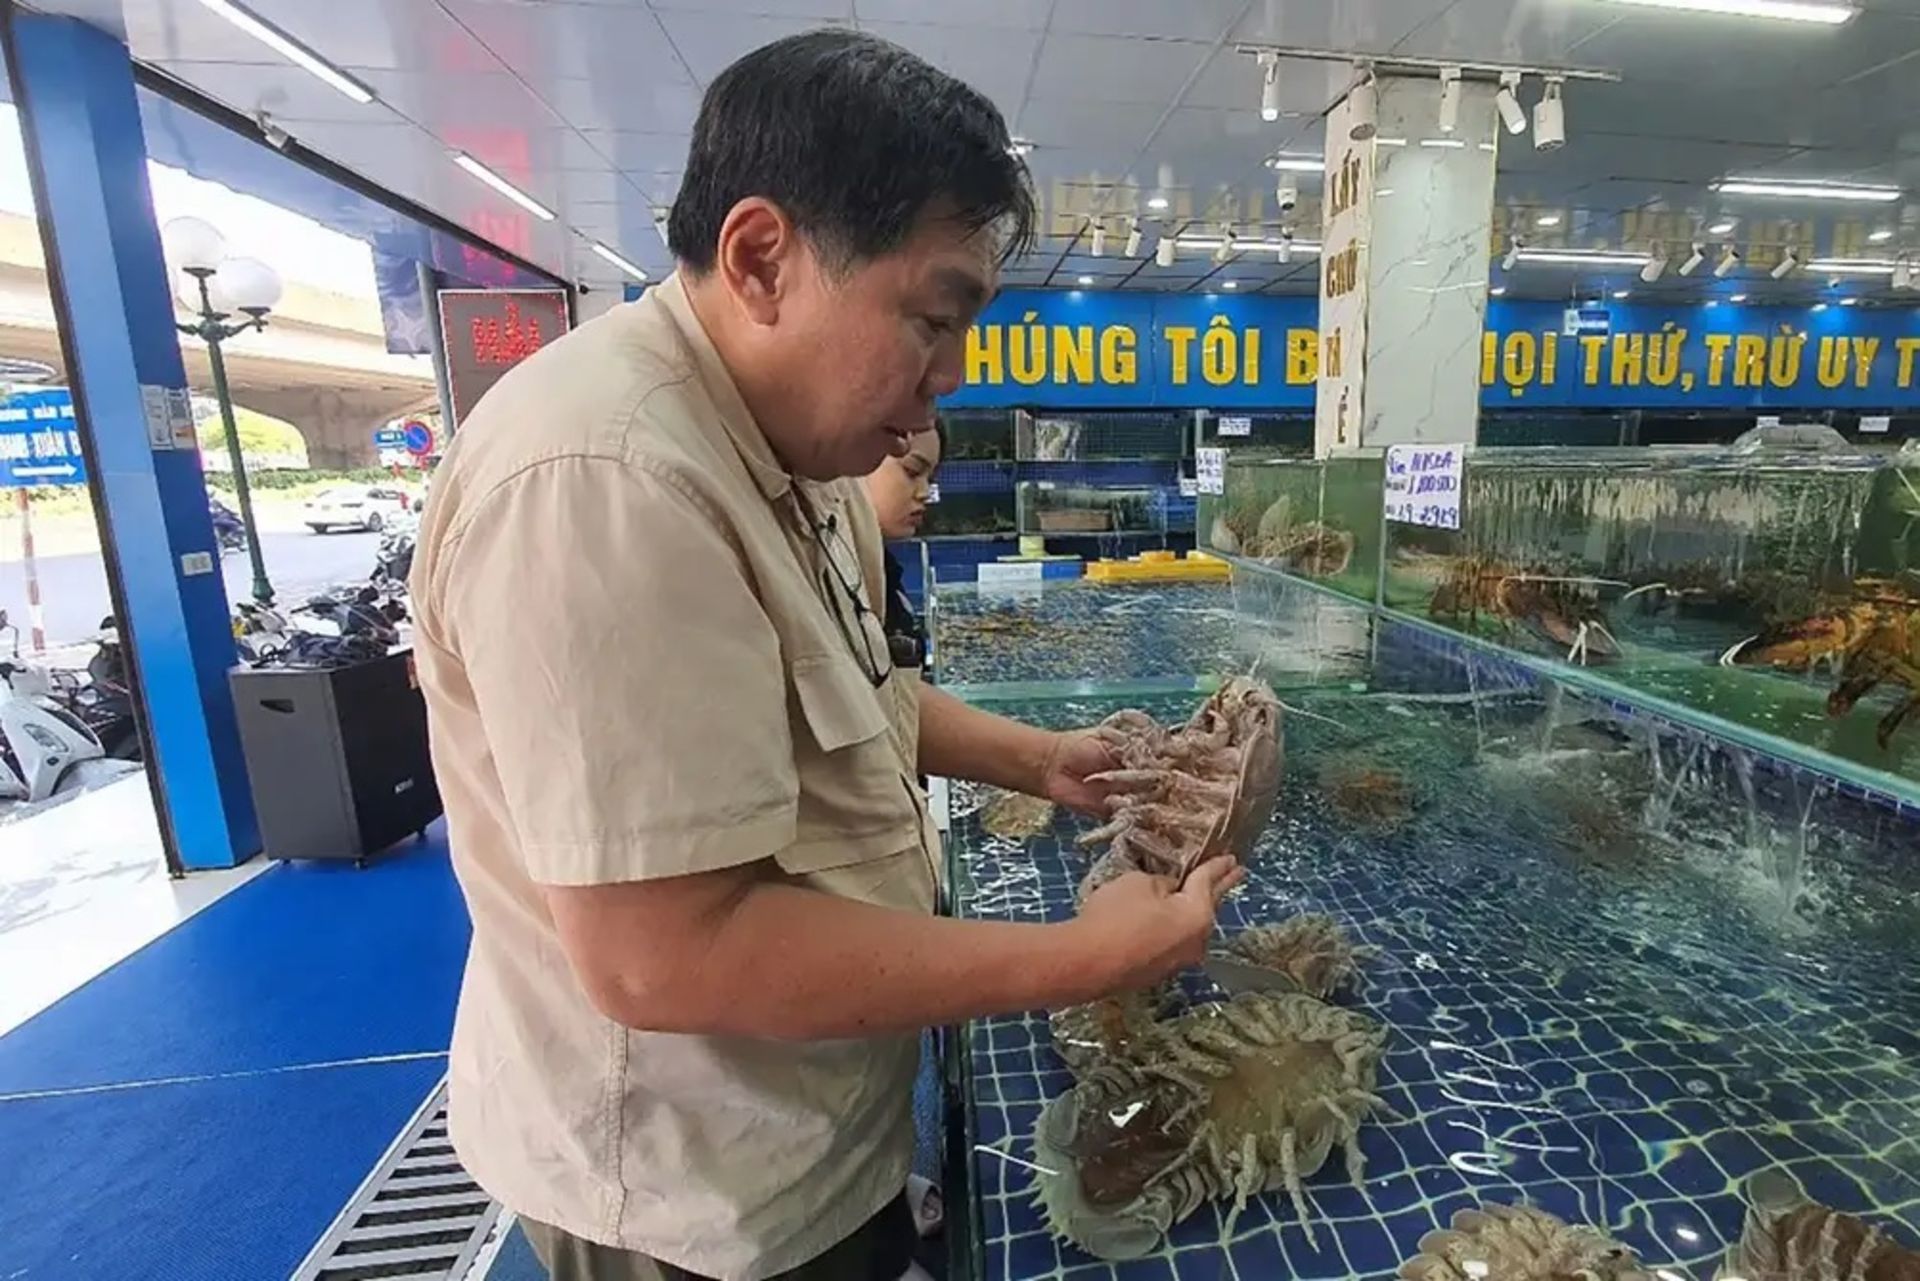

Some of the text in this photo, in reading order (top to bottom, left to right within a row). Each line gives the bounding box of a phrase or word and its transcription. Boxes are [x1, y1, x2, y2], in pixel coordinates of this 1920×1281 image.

[965, 310, 1137, 385] HÚNG
[1165, 314, 1260, 385] TÔI
[1285, 328, 1320, 385] B
[1579, 322, 1696, 392] THỨ,
[1704, 325, 1807, 386] TRỪ
[1817, 338, 1879, 387] UY
[1895, 338, 1920, 388] T
